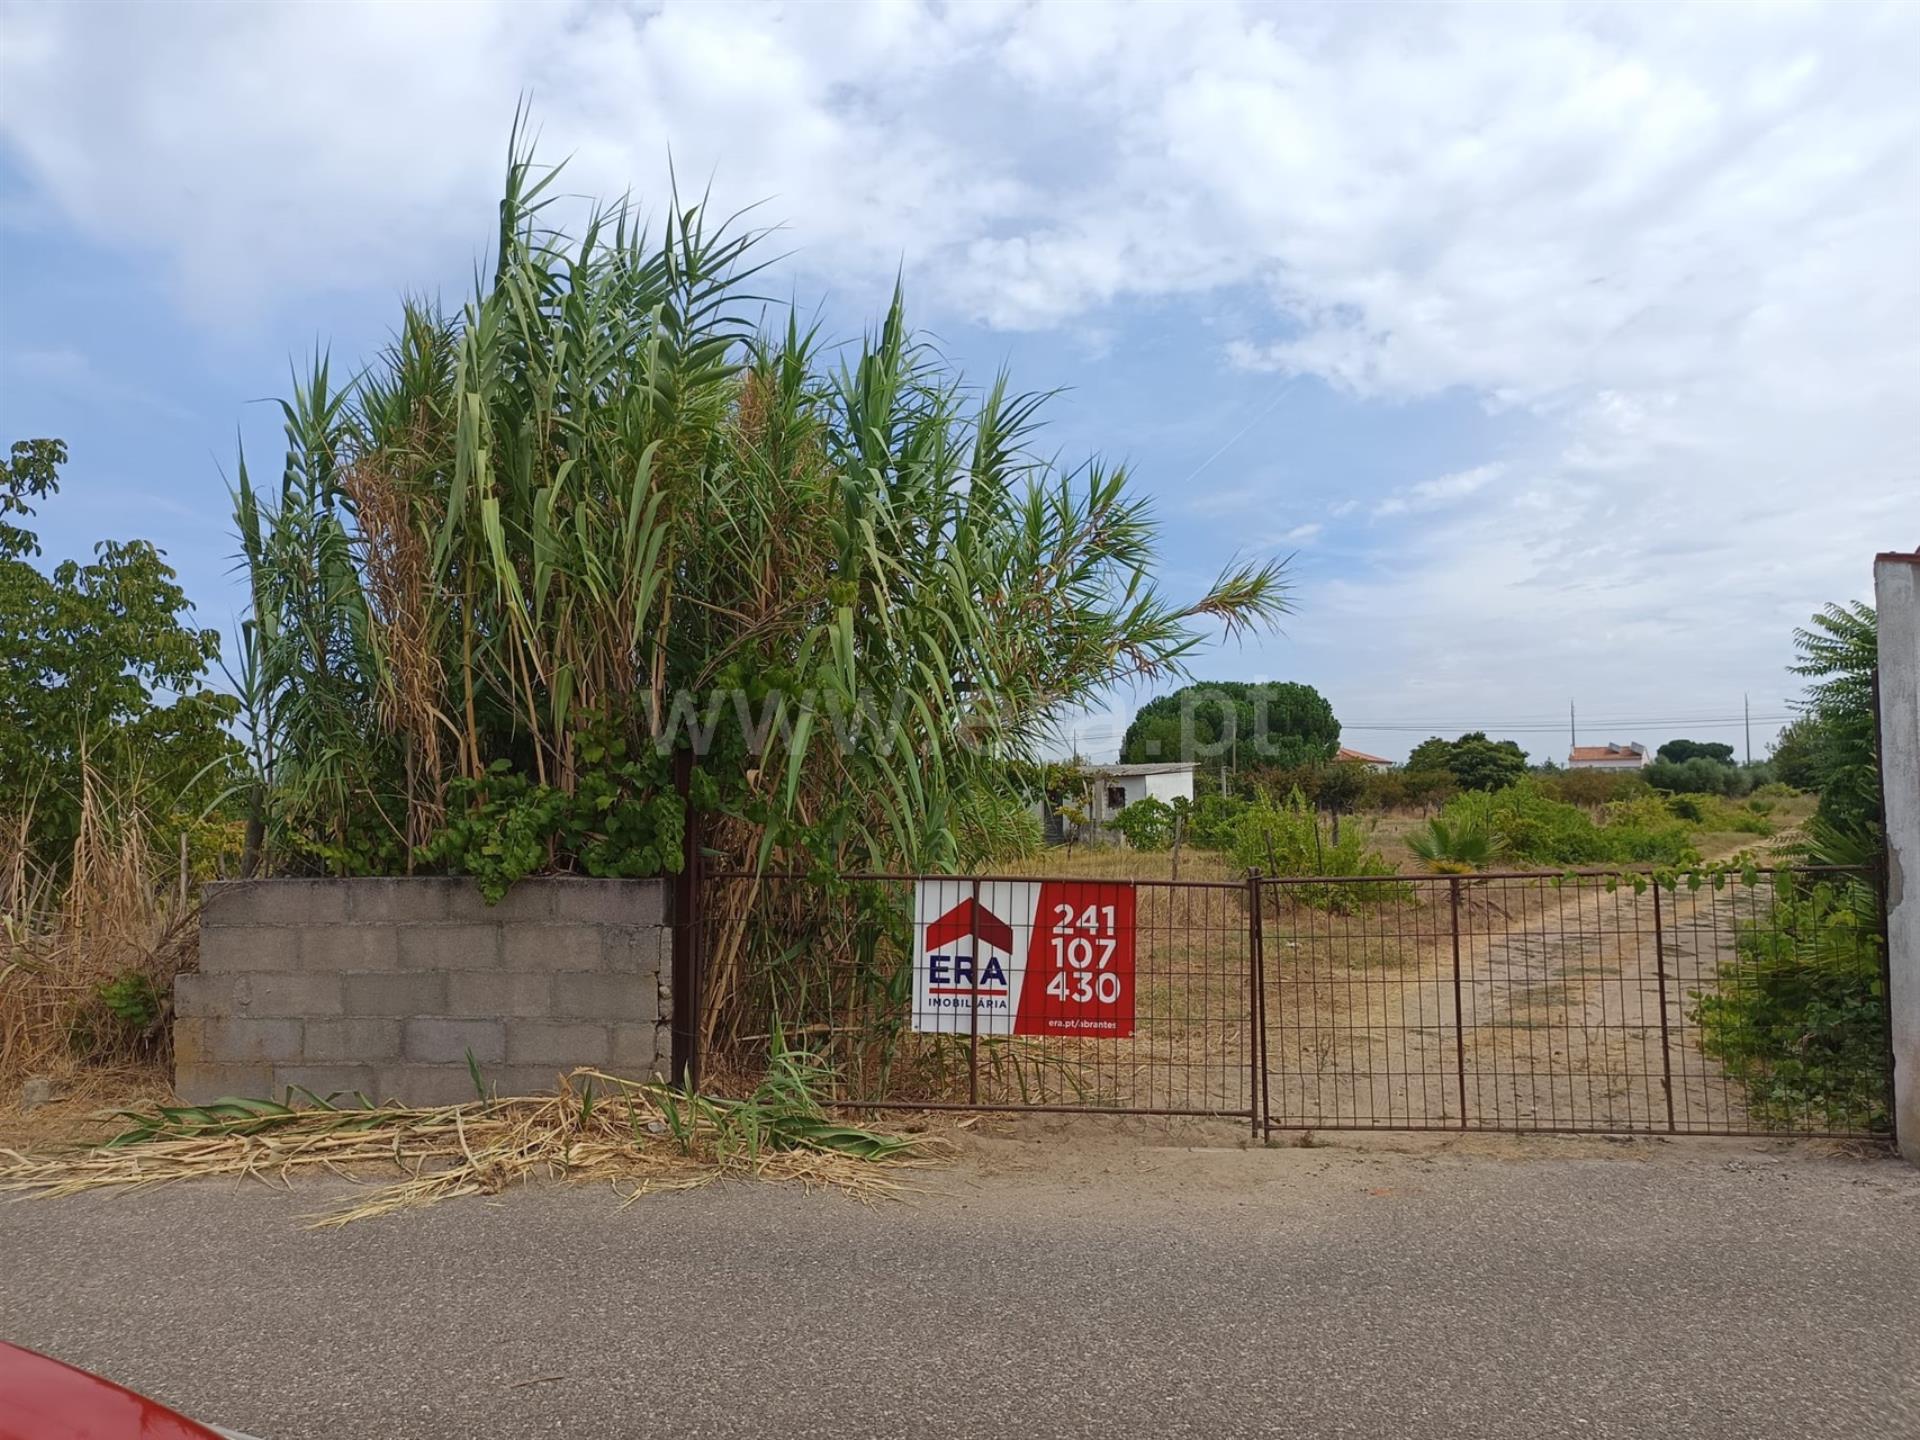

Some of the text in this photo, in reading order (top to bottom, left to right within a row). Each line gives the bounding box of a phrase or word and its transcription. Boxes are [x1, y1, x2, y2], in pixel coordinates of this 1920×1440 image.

[1053, 903, 1115, 936] 241
[1051, 937, 1117, 969] 107
[929, 955, 1007, 985] ERA
[928, 997, 1007, 1009] IMOBILÁRIA
[1046, 971, 1121, 1004] 430
[1048, 1020, 1117, 1029] era.pt/abrantes
